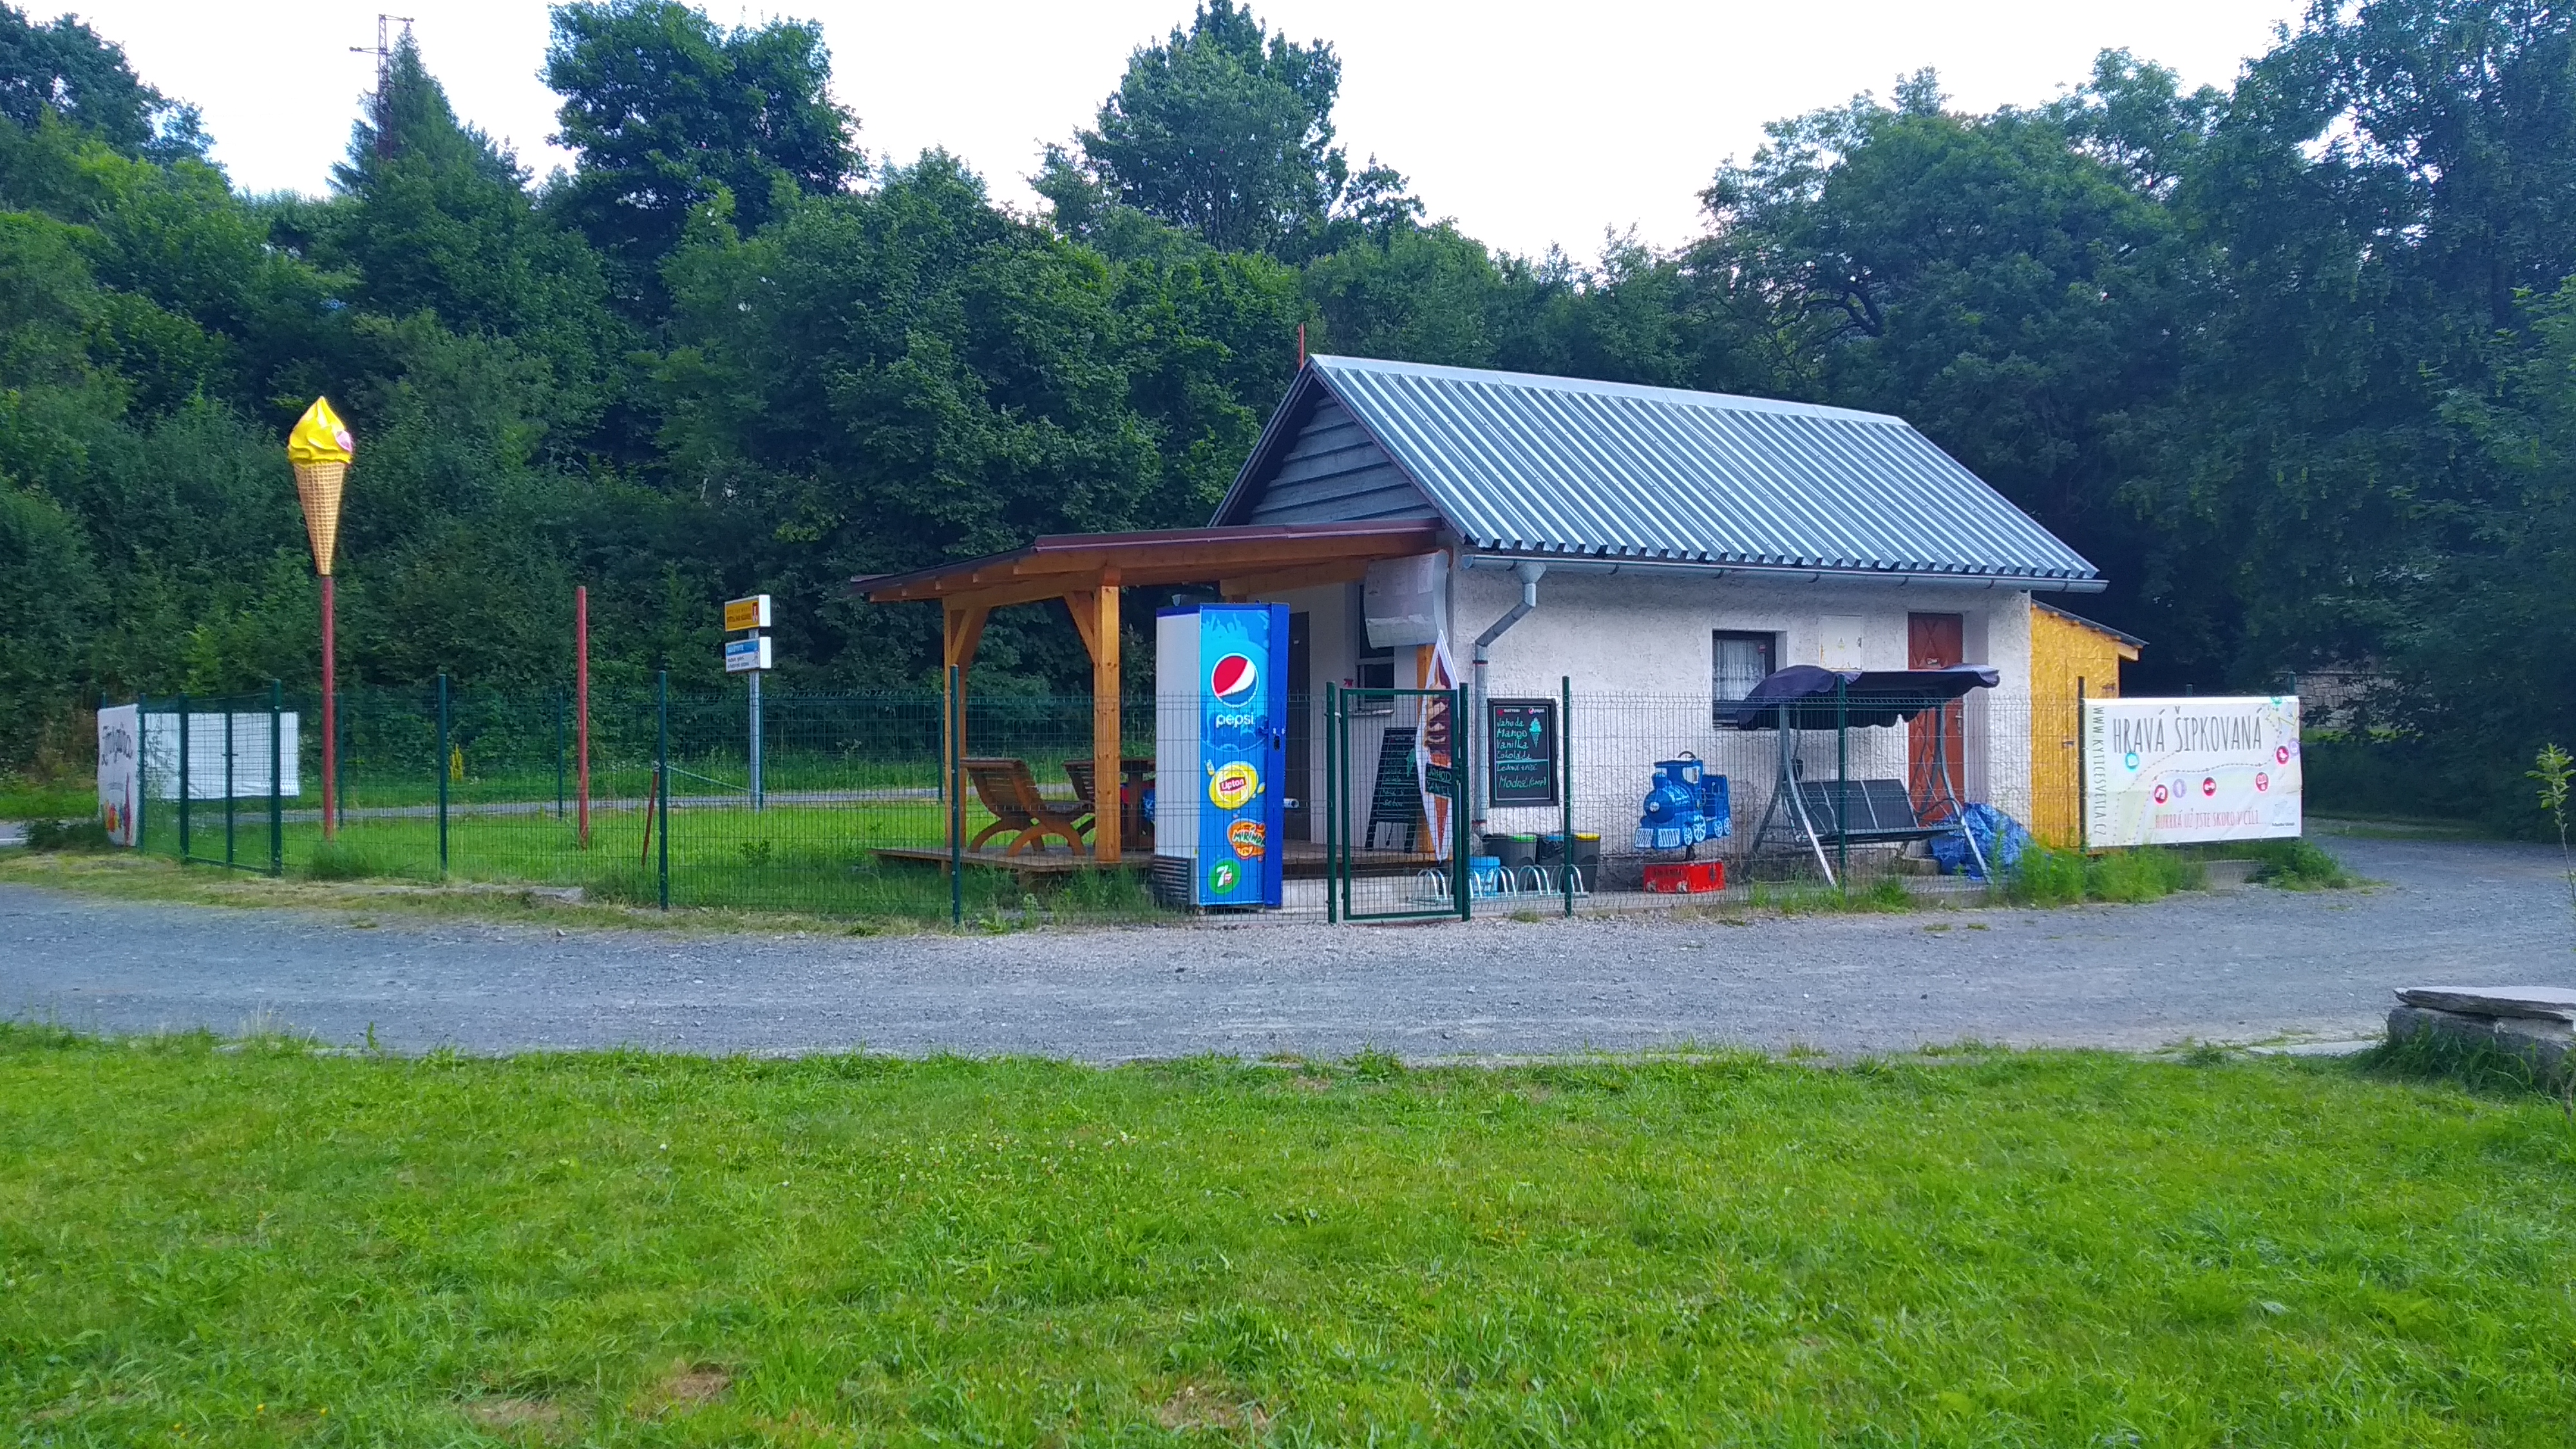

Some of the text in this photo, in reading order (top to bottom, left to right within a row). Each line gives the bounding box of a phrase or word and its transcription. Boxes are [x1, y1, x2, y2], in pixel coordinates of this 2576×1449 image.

[1216, 712, 1254, 728] pepsi
[1497, 716, 1524, 727] Jahoda
[1497, 728, 1528, 739] Mango
[2113, 706, 2262, 753] HRAVÁ ŠIPKOVANÁ
[1497, 739, 1528, 749] Vanilka
[1428, 766, 1452, 782] JAHOD
[1221, 778, 1245, 790] Lipton
[2195, 812, 2210, 829] JSTE
